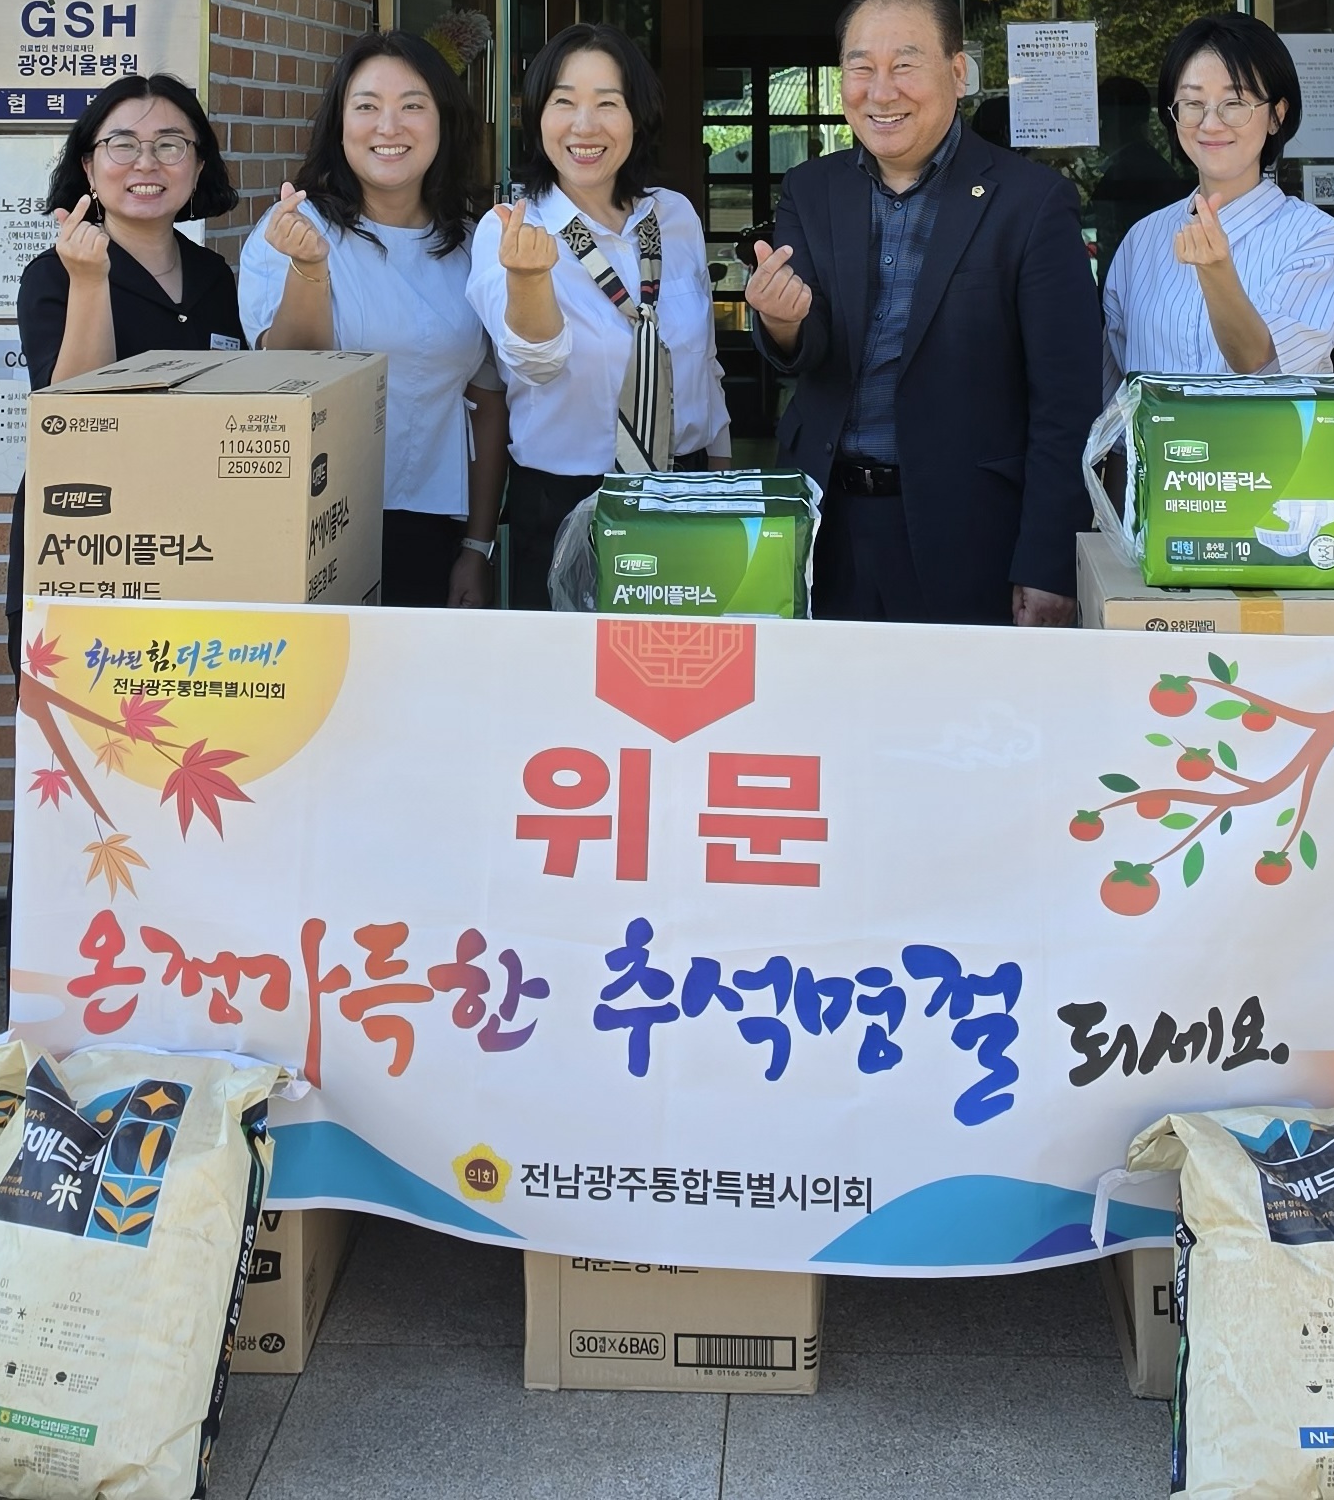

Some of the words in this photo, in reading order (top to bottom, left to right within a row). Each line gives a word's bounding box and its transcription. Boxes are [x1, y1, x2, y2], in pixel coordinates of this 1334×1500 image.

[21, 0, 137, 38] GSH
[17, 54, 138, 76] 광양서울병원
[69, 417, 119, 432] 유한킴벌리
[247, 414, 278, 424] 우리강산
[219, 439, 290, 454] 11043050
[228, 461, 283, 474] 2509602
[51, 491, 104, 509] 디펜드
[1165, 499, 1228, 513] 매직테이프
[1171, 540, 1194, 555] 대형
[1235, 541, 1251, 556] 10
[85, 638, 143, 693] 하나된
[229, 638, 287, 668] 미래!
[113, 677, 286, 700] 전남광주통합특별시의회
[593, 916, 1023, 1127] 추석명절
[467, 1167, 496, 1187] 의회
[46, 1173, 83, 1212] 米
[520, 1162, 874, 1215] 전남광주통합특별시의회
[69, 1291, 82, 1303] 02
